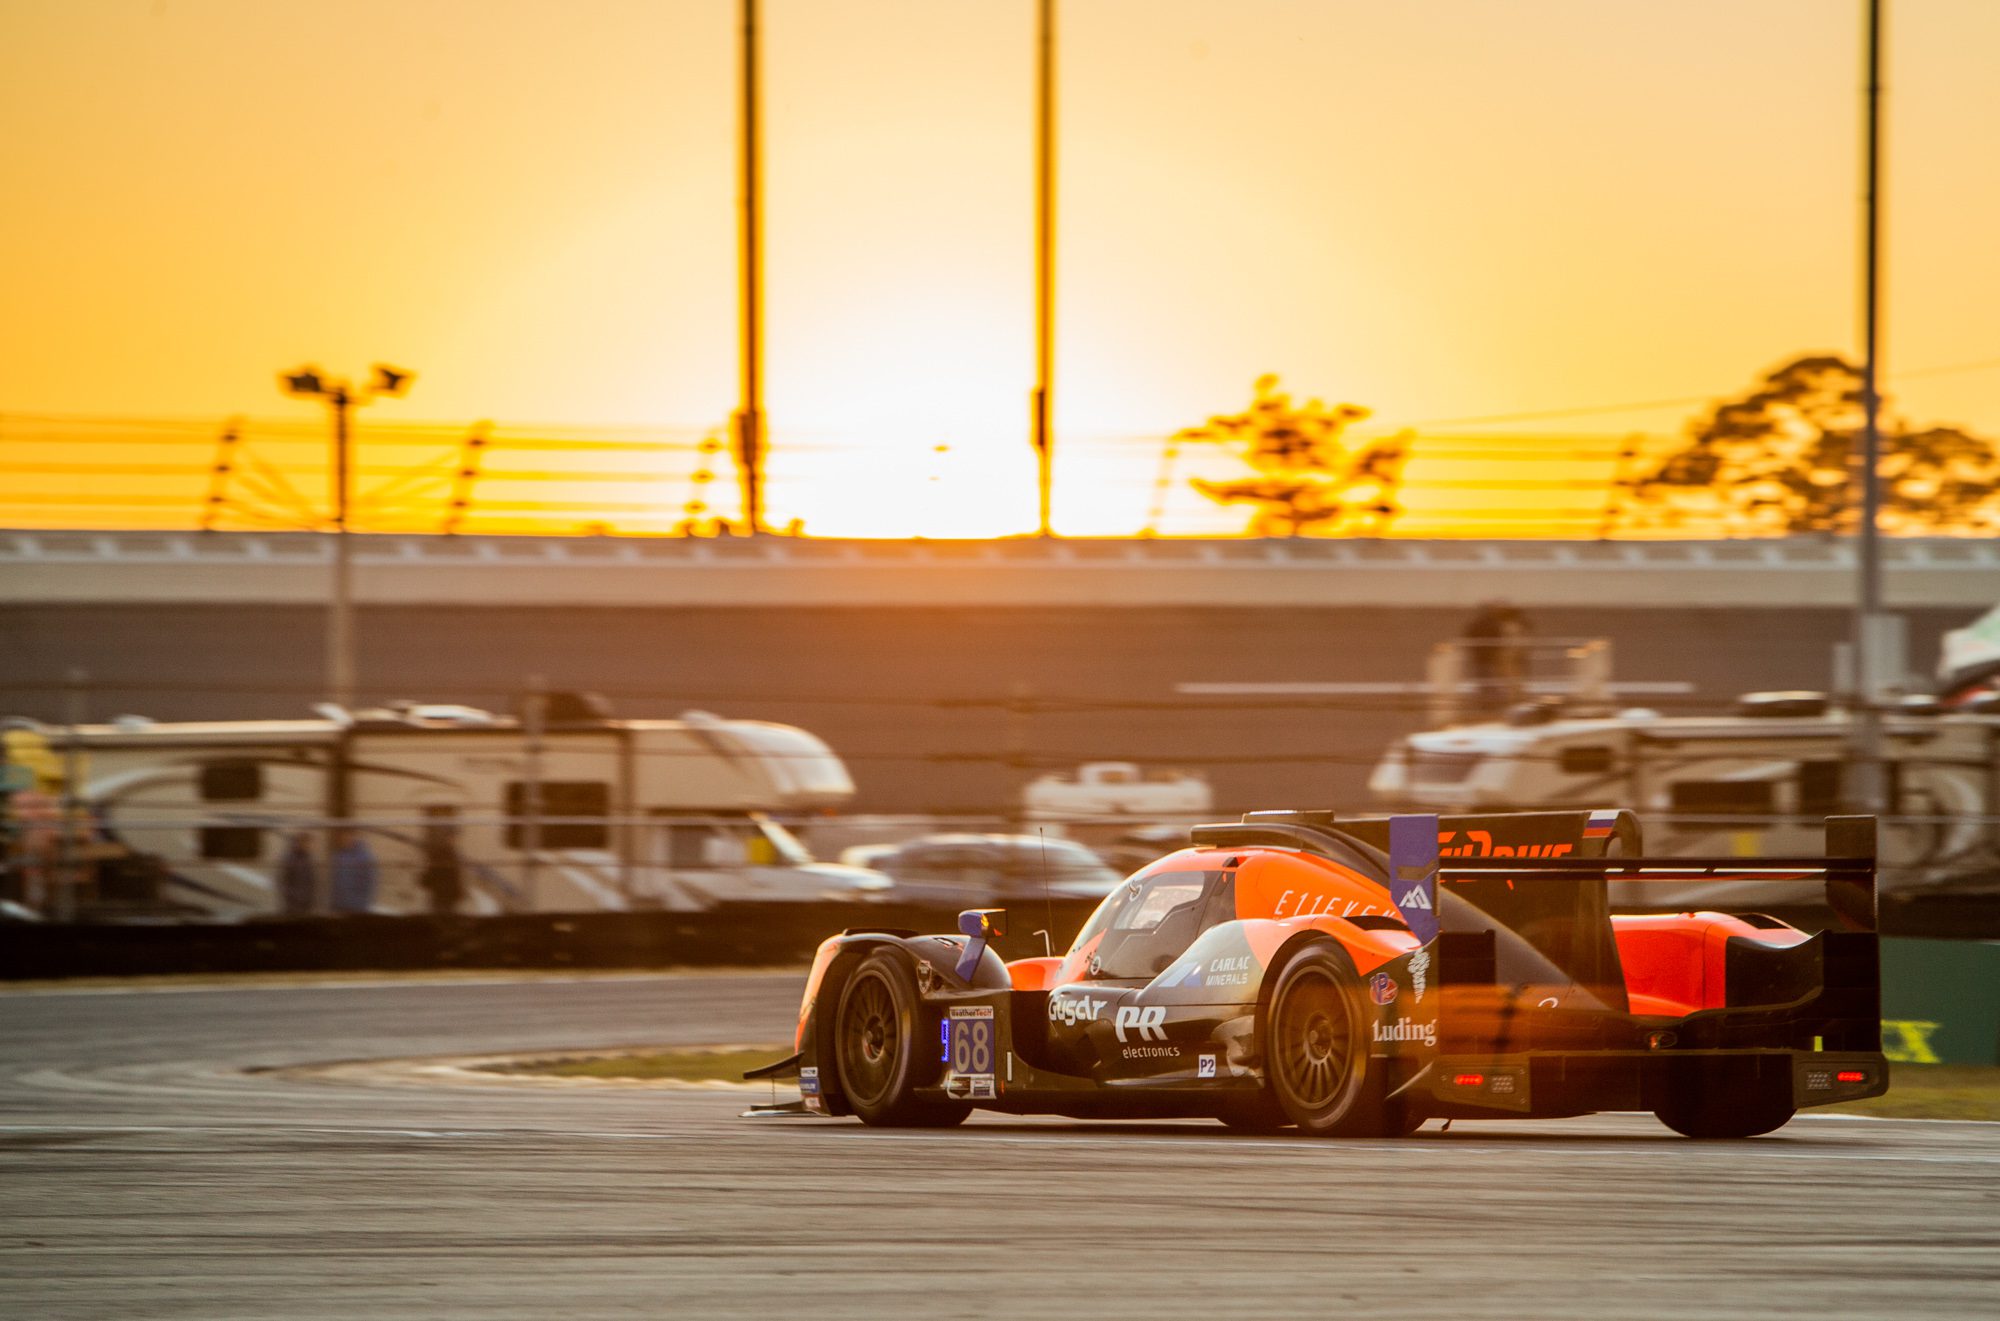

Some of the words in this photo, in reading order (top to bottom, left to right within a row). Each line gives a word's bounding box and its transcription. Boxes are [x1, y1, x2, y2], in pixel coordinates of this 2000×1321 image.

[1205, 973, 1248, 986] MINERALS
[1115, 1006, 1168, 1043] PR
[1372, 1016, 1437, 1047] Luding
[954, 1021, 990, 1073] 68
[1122, 1046, 1181, 1059] electronics
[1200, 1058, 1214, 1073] P2
